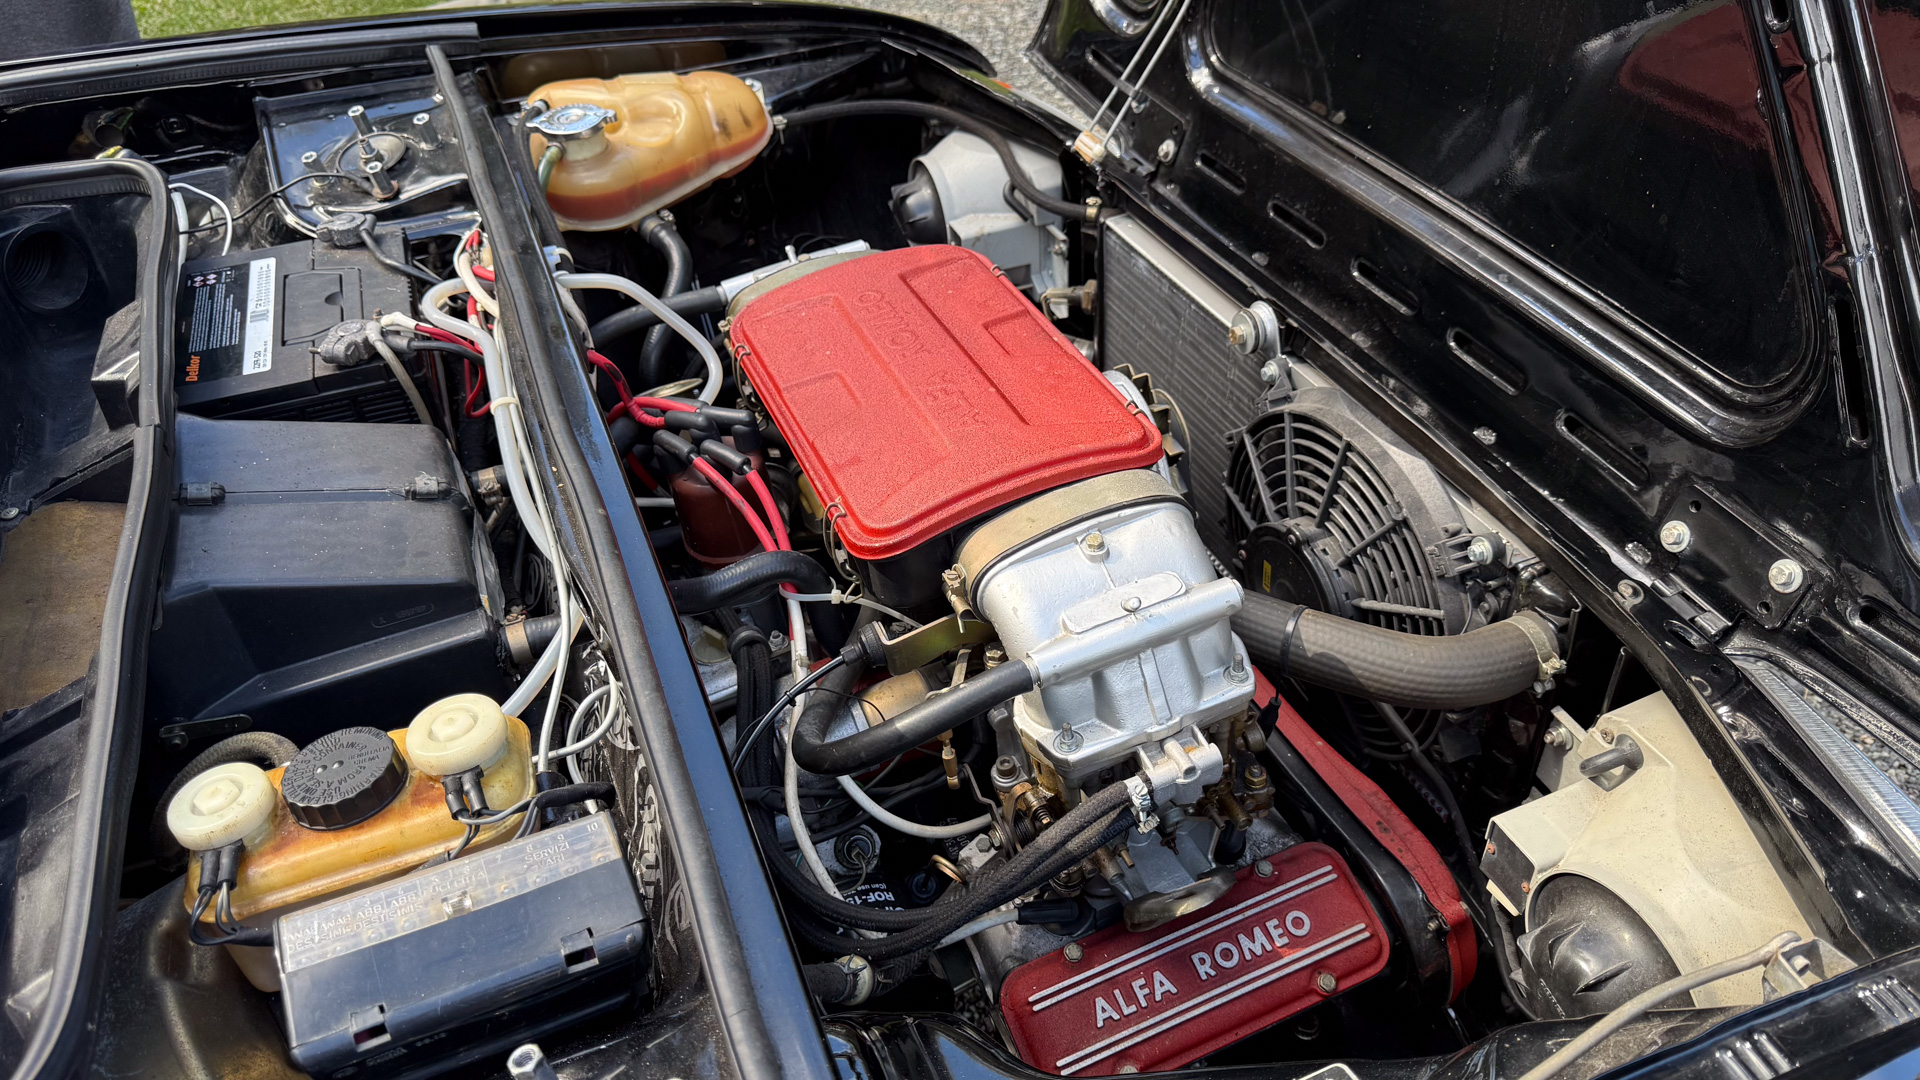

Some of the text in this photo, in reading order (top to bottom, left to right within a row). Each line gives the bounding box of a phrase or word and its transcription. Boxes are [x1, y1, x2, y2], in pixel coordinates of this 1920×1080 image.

[185, 355, 201, 382] Delkor
[341, 727, 387, 741] REMOVING
[314, 741, 367, 762] CONTAINER
[326, 780, 335, 788] A
[338, 764, 366, 786] FROM
[296, 784, 318, 796] ONLY
[320, 785, 341, 796] USE
[526, 844, 533, 853] 8
[557, 834, 565, 843] 9
[586, 822, 599, 832] 10
[524, 841, 570, 863] SERVIZI
[539, 854, 565, 869] VARI
[1095, 910, 1311, 1028] ALFA ROMEO
